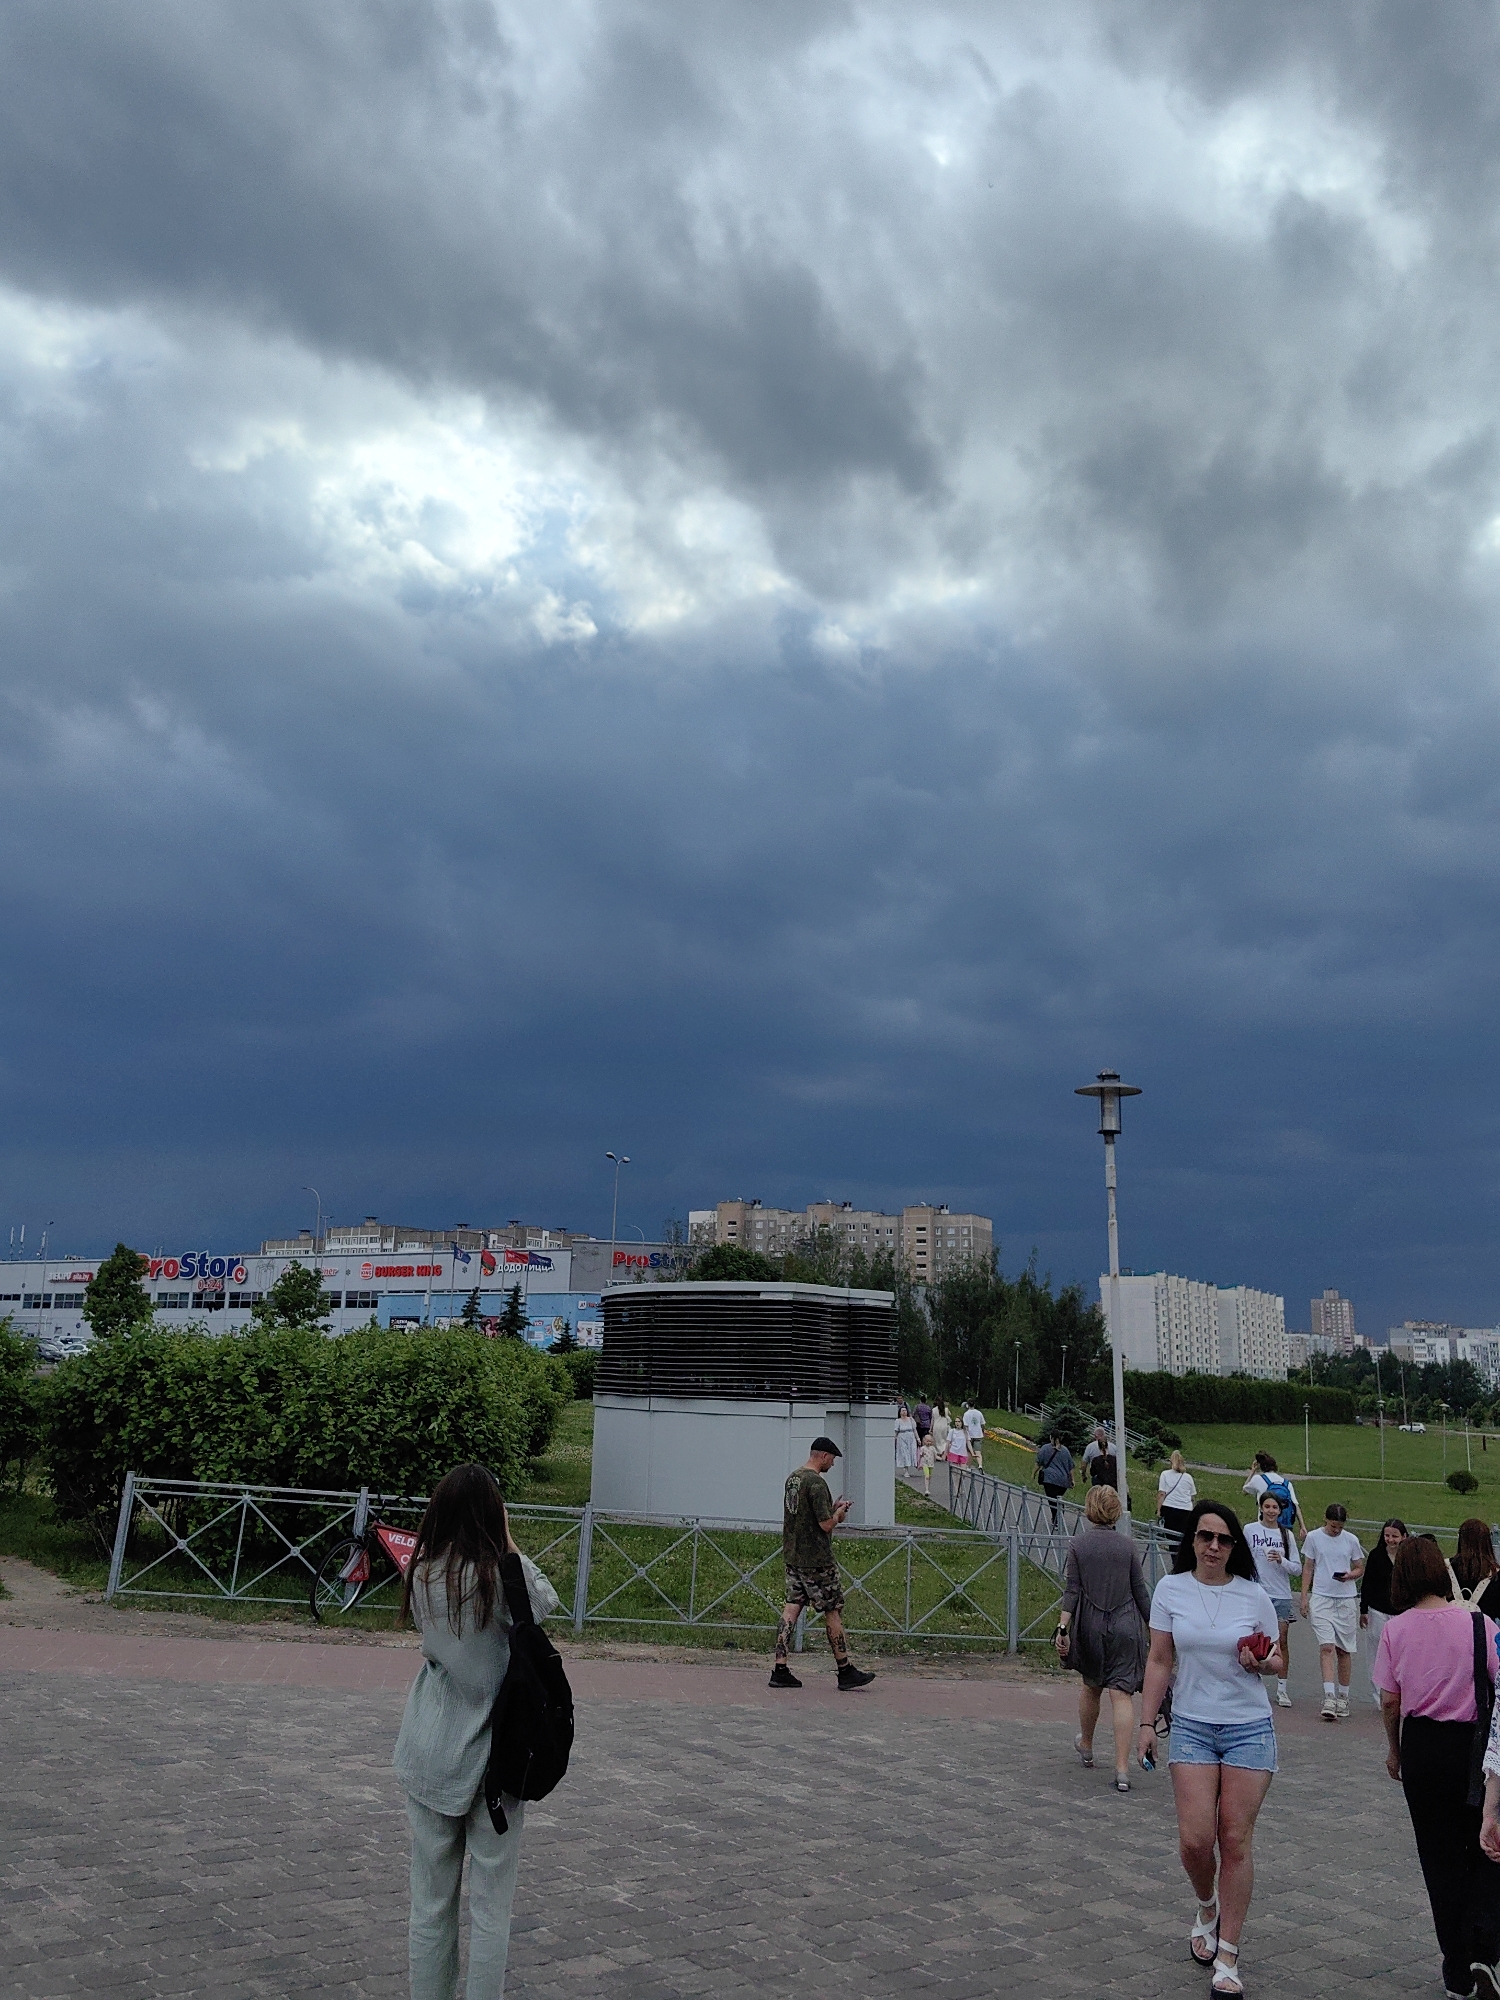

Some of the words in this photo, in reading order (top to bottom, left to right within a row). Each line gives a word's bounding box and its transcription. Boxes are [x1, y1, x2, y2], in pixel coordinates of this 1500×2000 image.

[375, 1266, 414, 1277] BURGER
[415, 1265, 442, 1277] KING
[497, 1264, 521, 1273] ДОДО
[198, 1279, 223, 1291] 0-24
[1266, 1537, 1285, 1548] Jean
